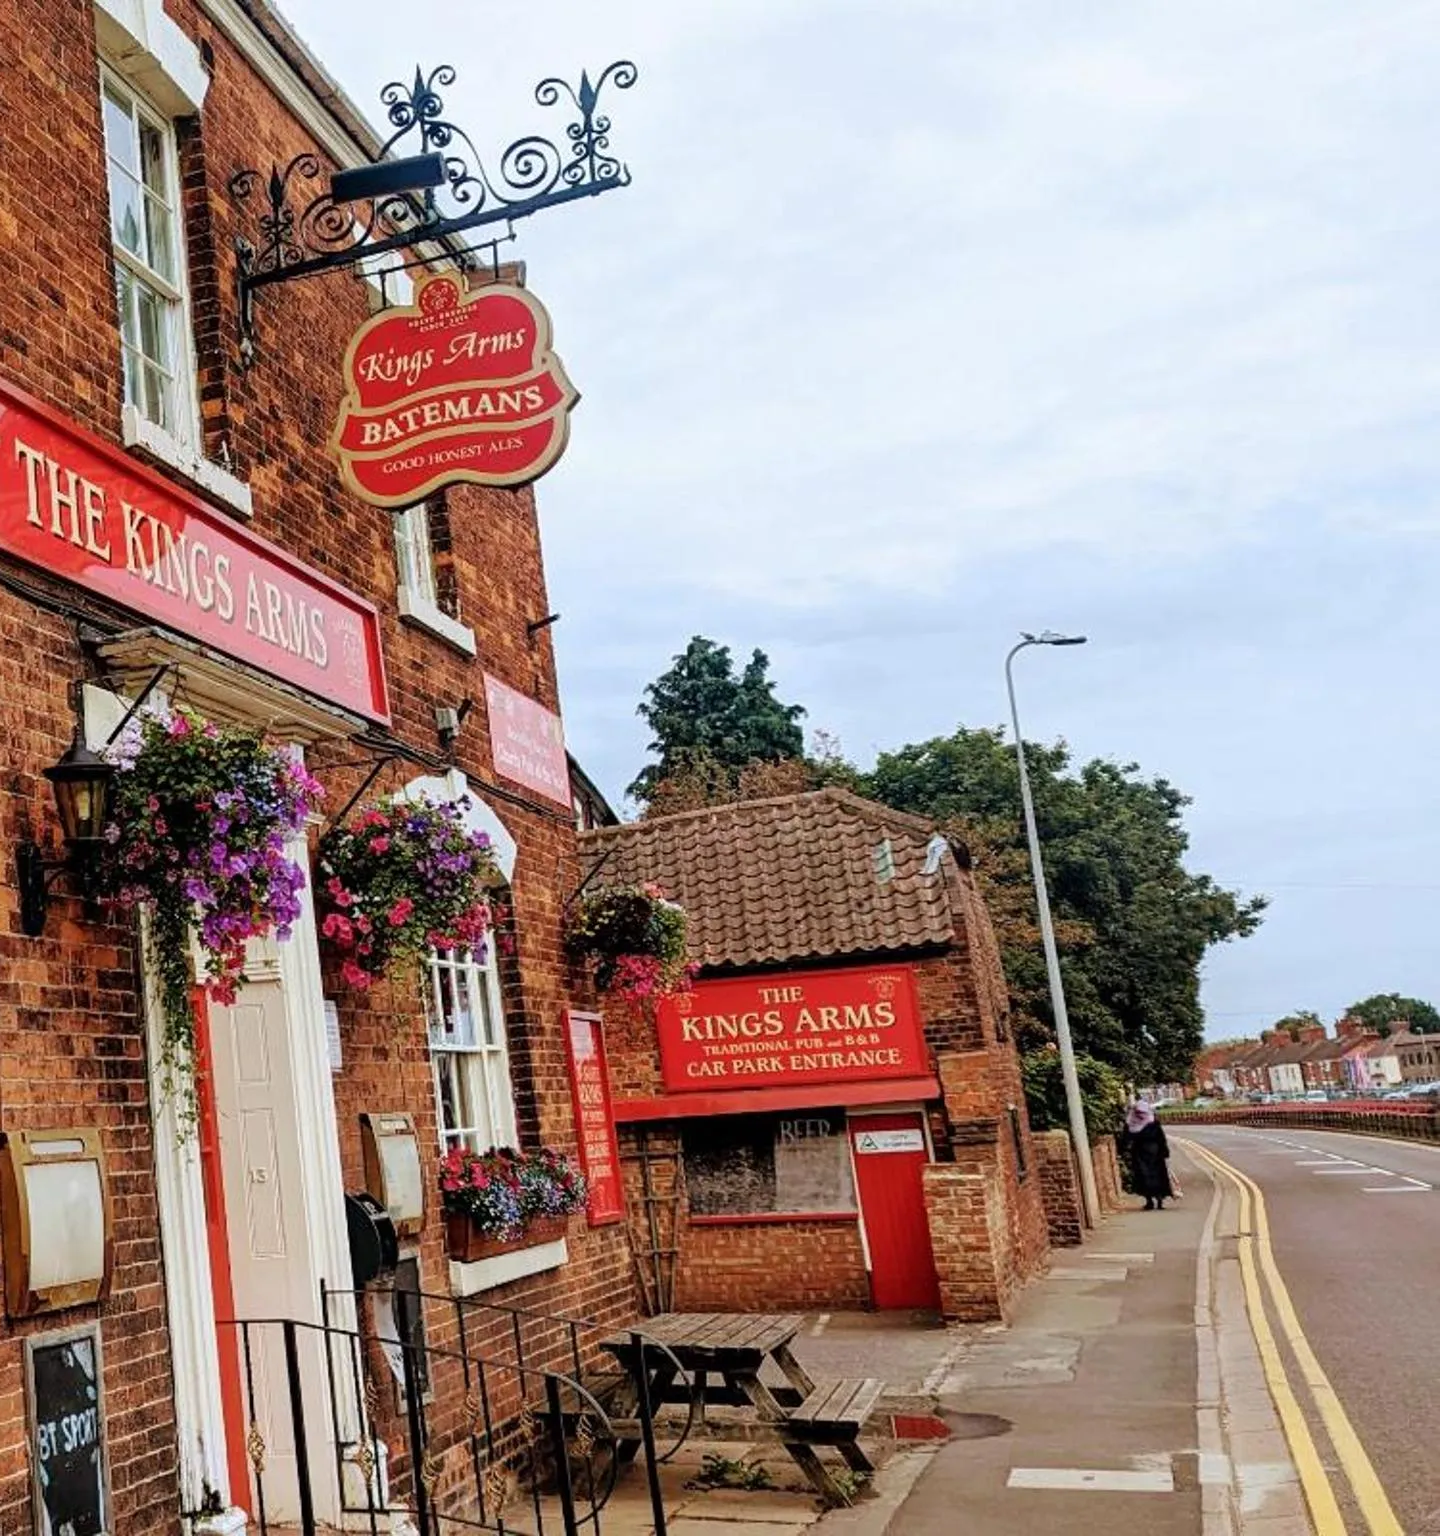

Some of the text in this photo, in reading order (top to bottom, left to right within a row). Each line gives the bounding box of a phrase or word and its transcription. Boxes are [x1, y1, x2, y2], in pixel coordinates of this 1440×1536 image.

[359, 328, 527, 387] Kings Arms
[360, 384, 544, 445] BATEMANS
[382, 436, 525, 474] GOOD HONEST ALES
[13, 436, 329, 669] THE KINGS ARMS
[758, 985, 805, 1005] THE
[680, 1001, 897, 1042] KINGS ARMS
[686, 1047, 903, 1078] CAR PARK ENTRANCE
[702, 1040, 793, 1057] TRADITIONAL
[796, 1037, 824, 1050] PUB
[39, 1420, 59, 1461] BT
